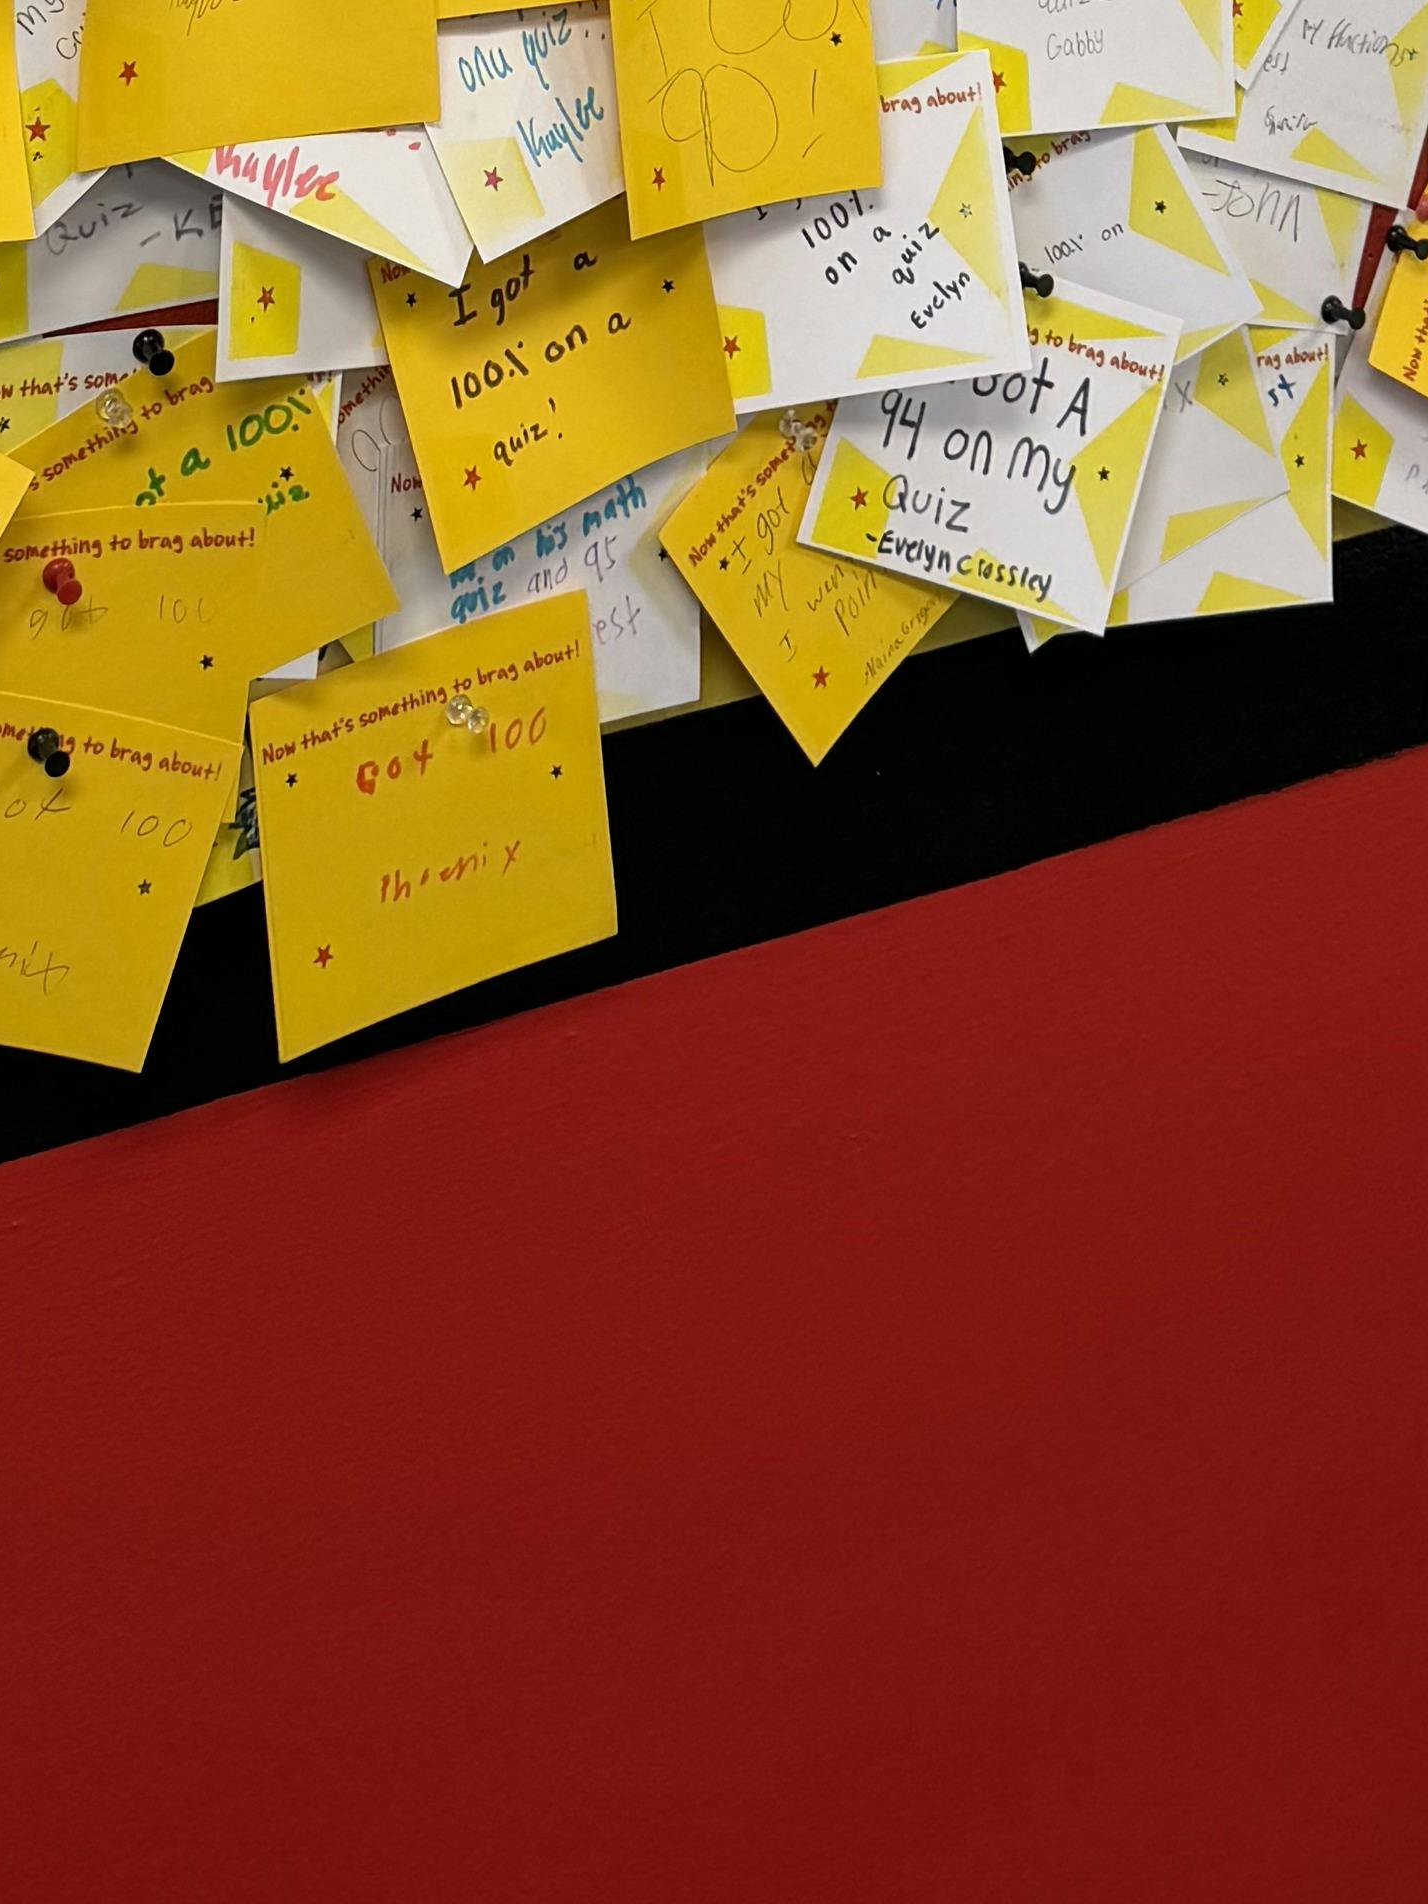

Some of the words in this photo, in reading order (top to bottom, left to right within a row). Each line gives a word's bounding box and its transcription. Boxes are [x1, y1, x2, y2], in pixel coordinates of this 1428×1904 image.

[449, 284, 477, 328] I
[490, 254, 536, 312] got
[573, 246, 598, 270] a
[545, 323, 587, 364] on
[607, 312, 632, 335] a
[493, 396, 563, 465] quiz!
[881, 389, 926, 459] 94
[943, 431, 991, 477] on
[882, 473, 971, 533] Quiz
[262, 742, 297, 766] Now
[302, 716, 356, 748] that's
[359, 688, 448, 729] something
[452, 678, 473, 697] to
[476, 662, 518, 689] brag
[521, 639, 580, 671] about!
[357, 740, 435, 795] Got
[486, 707, 548, 753] 100
